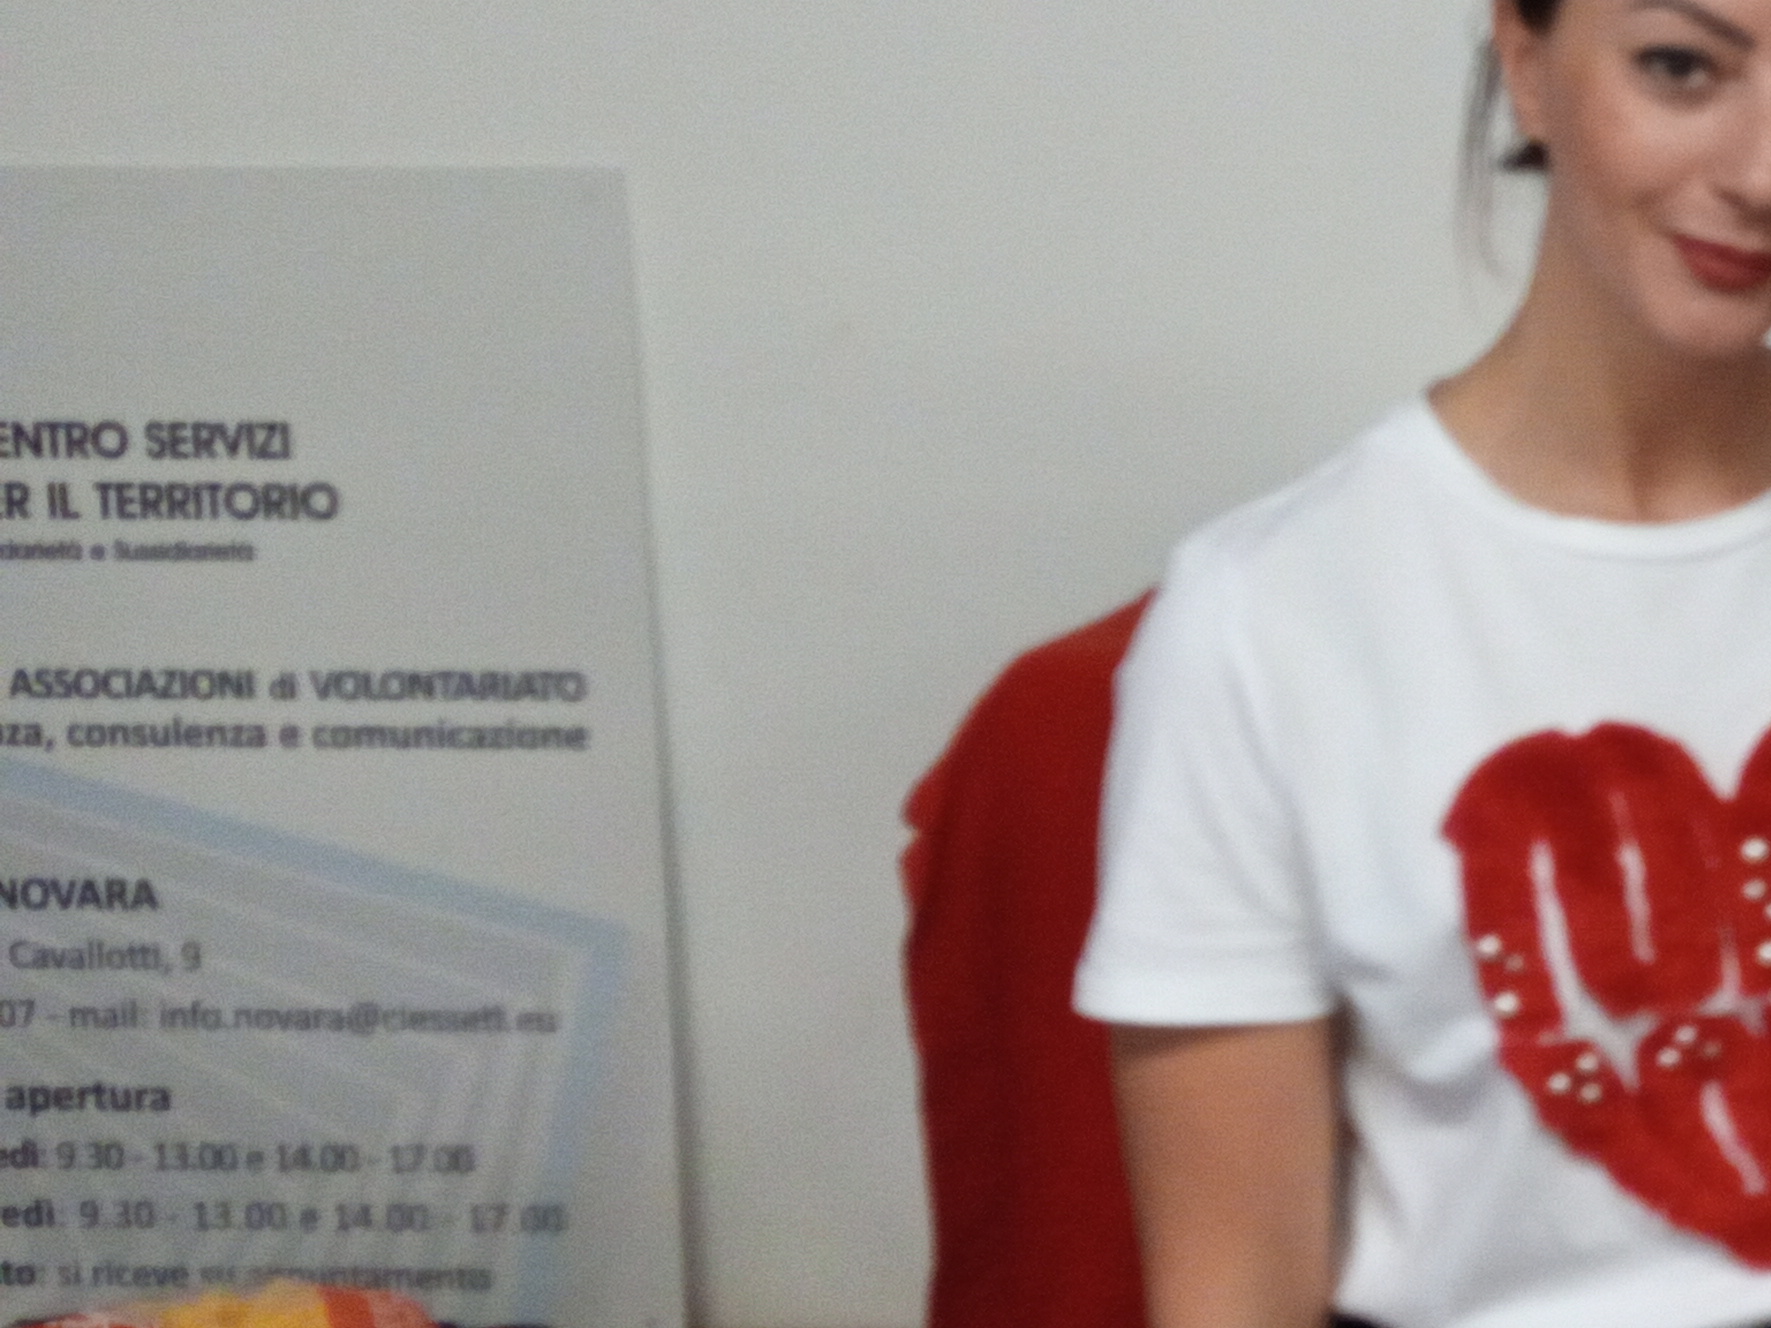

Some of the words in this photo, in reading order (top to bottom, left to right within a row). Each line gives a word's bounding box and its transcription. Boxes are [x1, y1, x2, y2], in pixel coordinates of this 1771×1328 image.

[145, 421, 291, 461] SERVIZI
[47, 482, 80, 520] IL
[95, 481, 339, 521] TERRITORIO
[9, 668, 256, 700] ASSOCIAZIONI
[308, 670, 588, 703] VOLONTARIATO
[66, 714, 267, 749] consulenza
[311, 717, 590, 751] comunicazione
[0, 877, 160, 910] NOVARA
[5, 1082, 172, 1116] apertura
